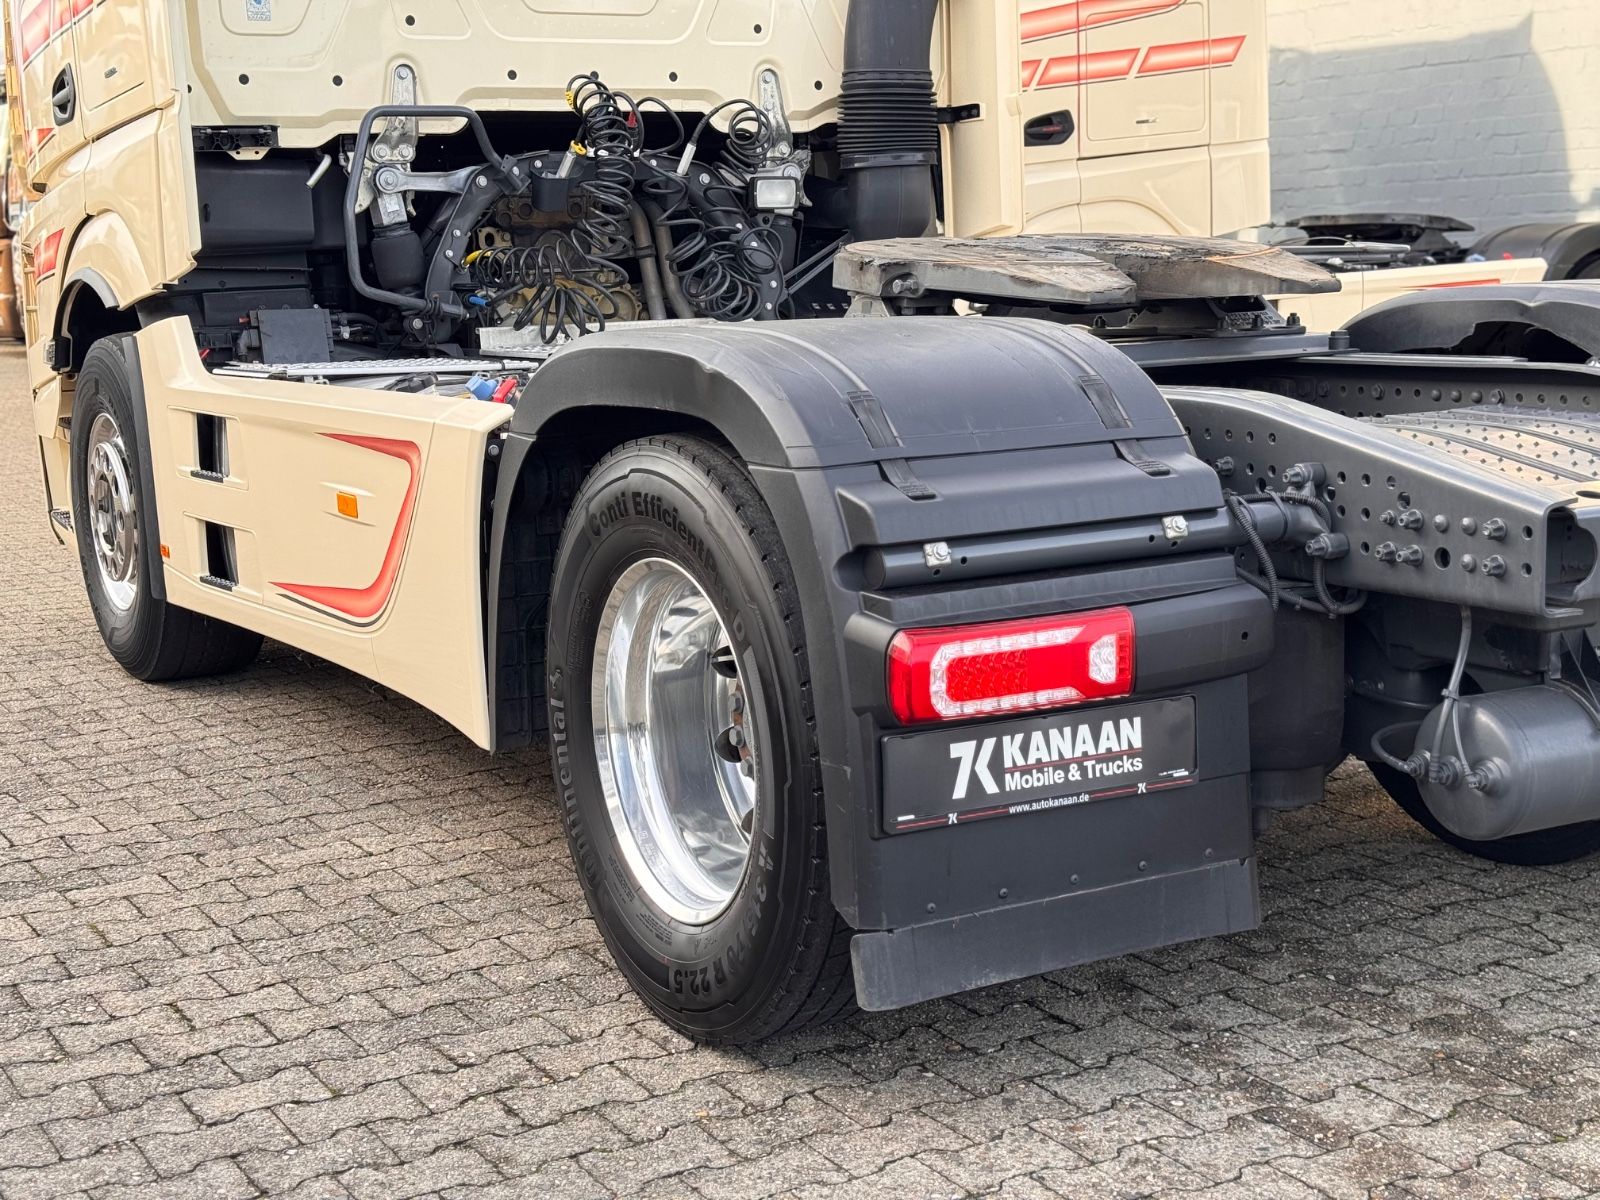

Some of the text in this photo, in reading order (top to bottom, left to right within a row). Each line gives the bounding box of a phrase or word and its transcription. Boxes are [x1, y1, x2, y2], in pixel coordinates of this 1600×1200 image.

[589, 491, 630, 537] Conti
[1002, 716, 1142, 769] KANAAN
[1005, 767, 1064, 792] Mobile
[1068, 765, 1081, 781] &
[1084, 756, 1143, 778] Trucks
[1008, 793, 1090, 814] www.autokanaan.de
[673, 965, 711, 995] 22.5
